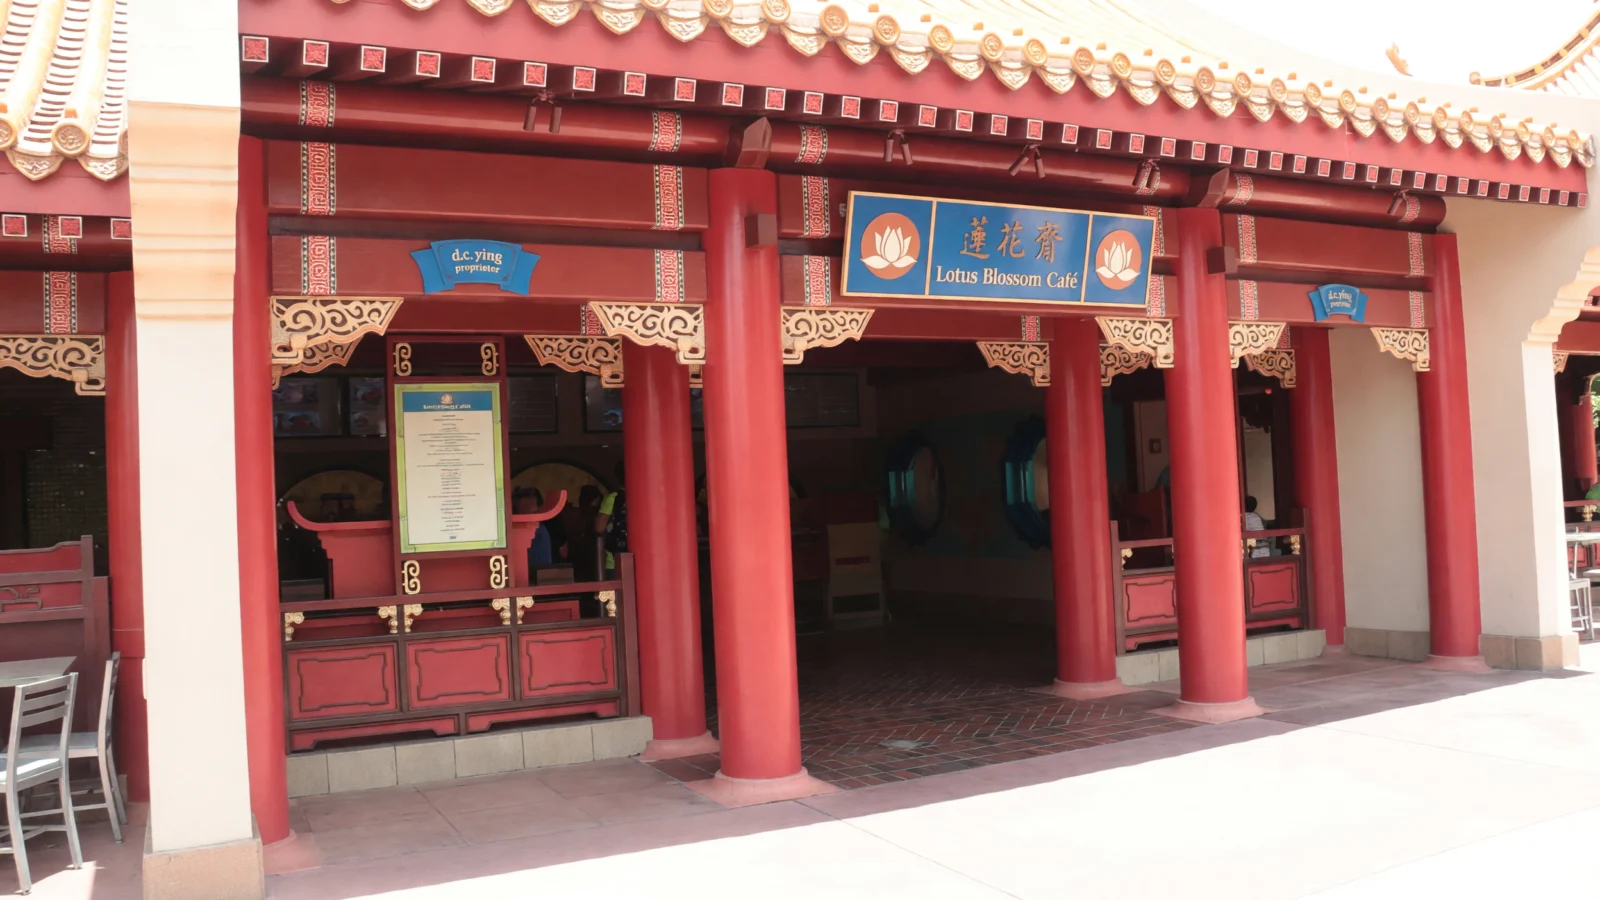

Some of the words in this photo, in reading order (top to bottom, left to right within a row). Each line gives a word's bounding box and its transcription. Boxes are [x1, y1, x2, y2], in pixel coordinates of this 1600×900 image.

[451, 248, 473, 261] d.c.
[475, 248, 503, 265] ying
[455, 263, 500, 274] proprietor
[936, 265, 978, 284] Lotus
[983, 267, 1041, 287] Blossom
[1046, 271, 1078, 289] Café
